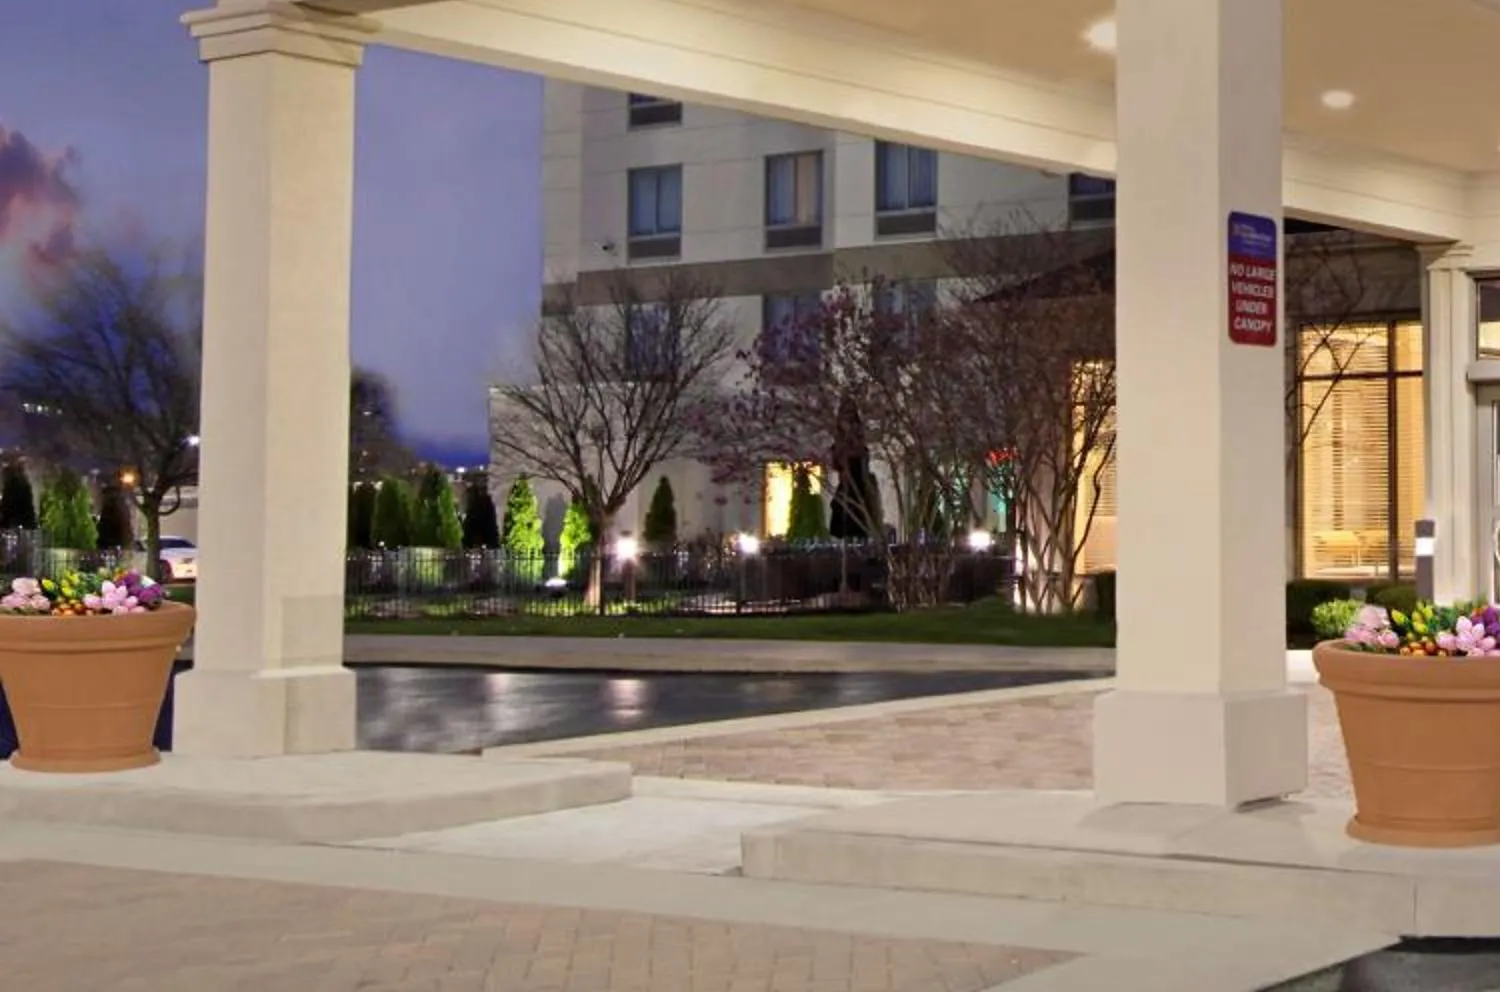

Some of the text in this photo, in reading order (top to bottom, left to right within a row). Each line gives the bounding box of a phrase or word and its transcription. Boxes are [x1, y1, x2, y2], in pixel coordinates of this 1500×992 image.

[1230, 263, 1276, 281] NO LARGE
[1231, 281, 1274, 297] VEHICLES
[1235, 300, 1268, 314] UNDER
[1234, 317, 1273, 332] CANOPY
